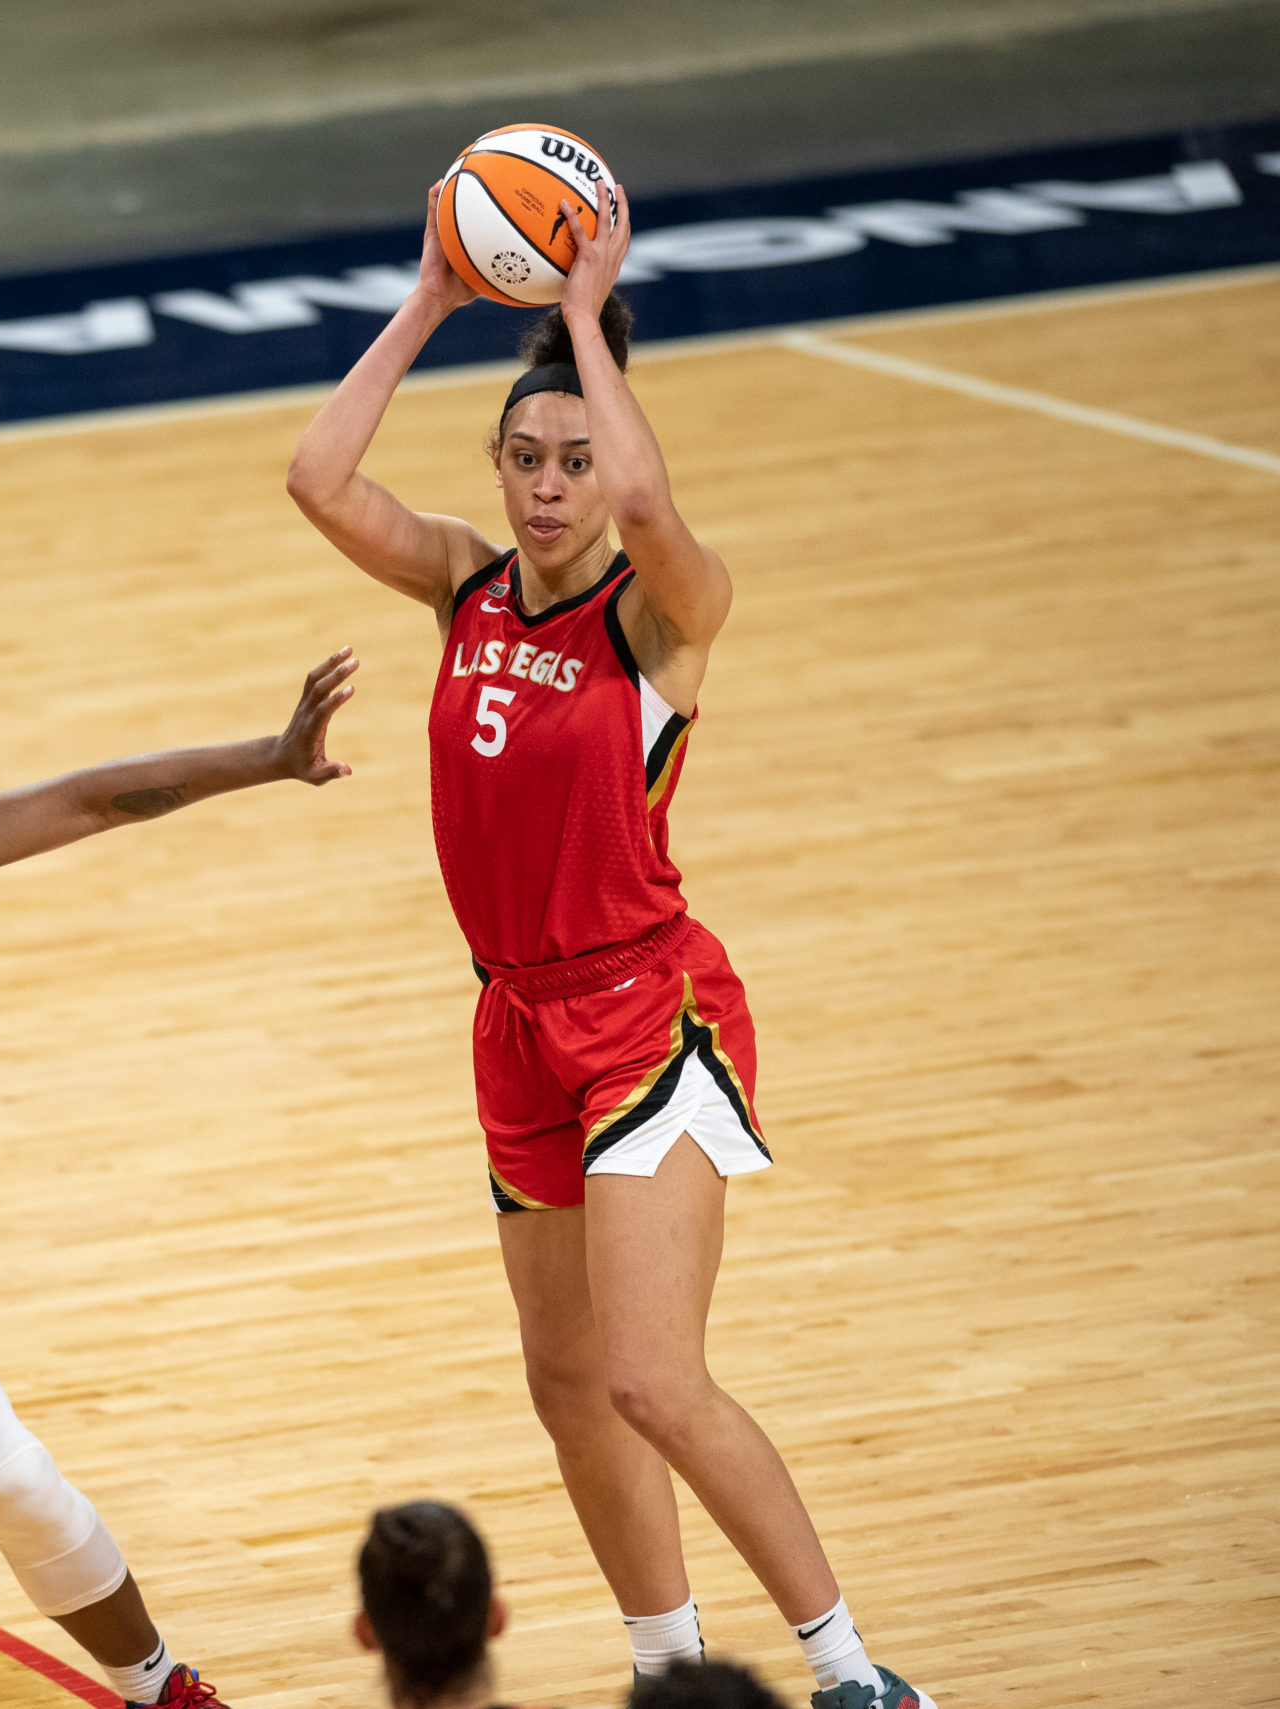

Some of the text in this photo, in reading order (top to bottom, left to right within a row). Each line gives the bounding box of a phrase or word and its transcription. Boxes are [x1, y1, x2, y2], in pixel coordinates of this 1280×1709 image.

[514, 189, 531, 204] GAME
[531, 202, 545, 217] BALL
[452, 640, 584, 692] LAS EGAS
[470, 685, 517, 757] 5
